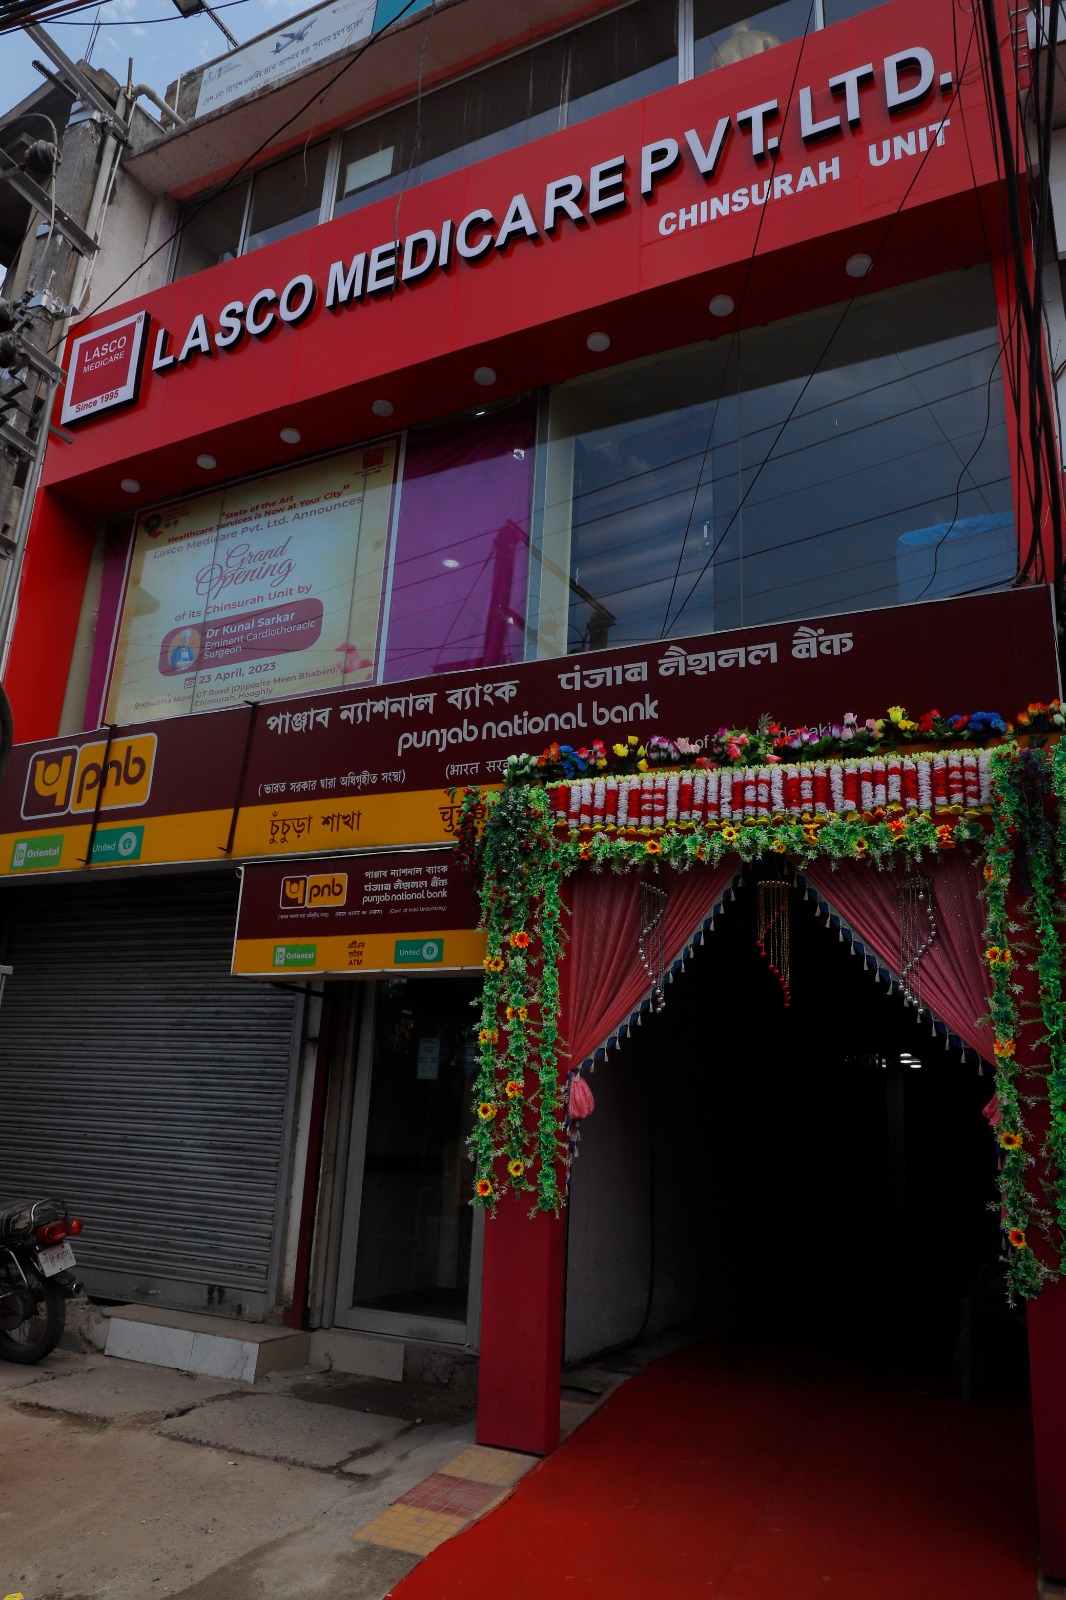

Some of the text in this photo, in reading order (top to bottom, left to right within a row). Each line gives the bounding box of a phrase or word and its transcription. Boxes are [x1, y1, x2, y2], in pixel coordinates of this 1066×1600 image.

[658, 119, 951, 236] CHINSURAH UNIT
[152, 46, 953, 373] LASCO MEDICARE PVT. LTD.
[82, 350, 125, 374] MEDICARE
[84, 335, 127, 363] LASCO
[75, 389, 119, 413] Since 1995
[167, 525, 214, 544] Healthcare
[216, 515, 253, 531] Services
[254, 511, 262, 520] is
[264, 506, 286, 517] Now
[288, 503, 297, 511] at
[299, 496, 322, 509] Your
[250, 505, 260, 514] of
[261, 502, 276, 511] the
[153, 495, 364, 559] Lasco Medicare Pvt. Ltd. Announces
[225, 536, 294, 569] Grand
[195, 556, 297, 601] Opening
[174, 583, 313, 622] of its Chinsurah Unit by
[204, 619, 316, 651] Eminent Cardiothoracic
[206, 610, 296, 639] Dr Kunal Sarkar
[203, 645, 242, 661] Surgeon
[558, 625, 854, 691] पंजाब नैशनल बैंक
[199, 661, 276, 684] 23 April, 2023
[238, 687, 274, 700] Hooghly
[266, 680, 520, 735] পাঞ্জাব ন্যাশনাল ব্যাংক
[397, 693, 659, 757] punjab national bank
[76, 745, 147, 804] pnb
[290, 778, 317, 793] সরকার
[320, 775, 337, 790] দ্বারা
[339, 771, 379, 792] অধিগৃহীত
[445, 762, 480, 780] (भारत
[269, 810, 362, 844] চুঁচুড়া শাখা
[27, 847, 60, 858] Oriental
[92, 841, 117, 853] United
[308, 878, 343, 904] pnb
[362, 888, 448, 905] punjab national bank
[286, 952, 314, 960] Oriental
[399, 948, 421, 957] United
